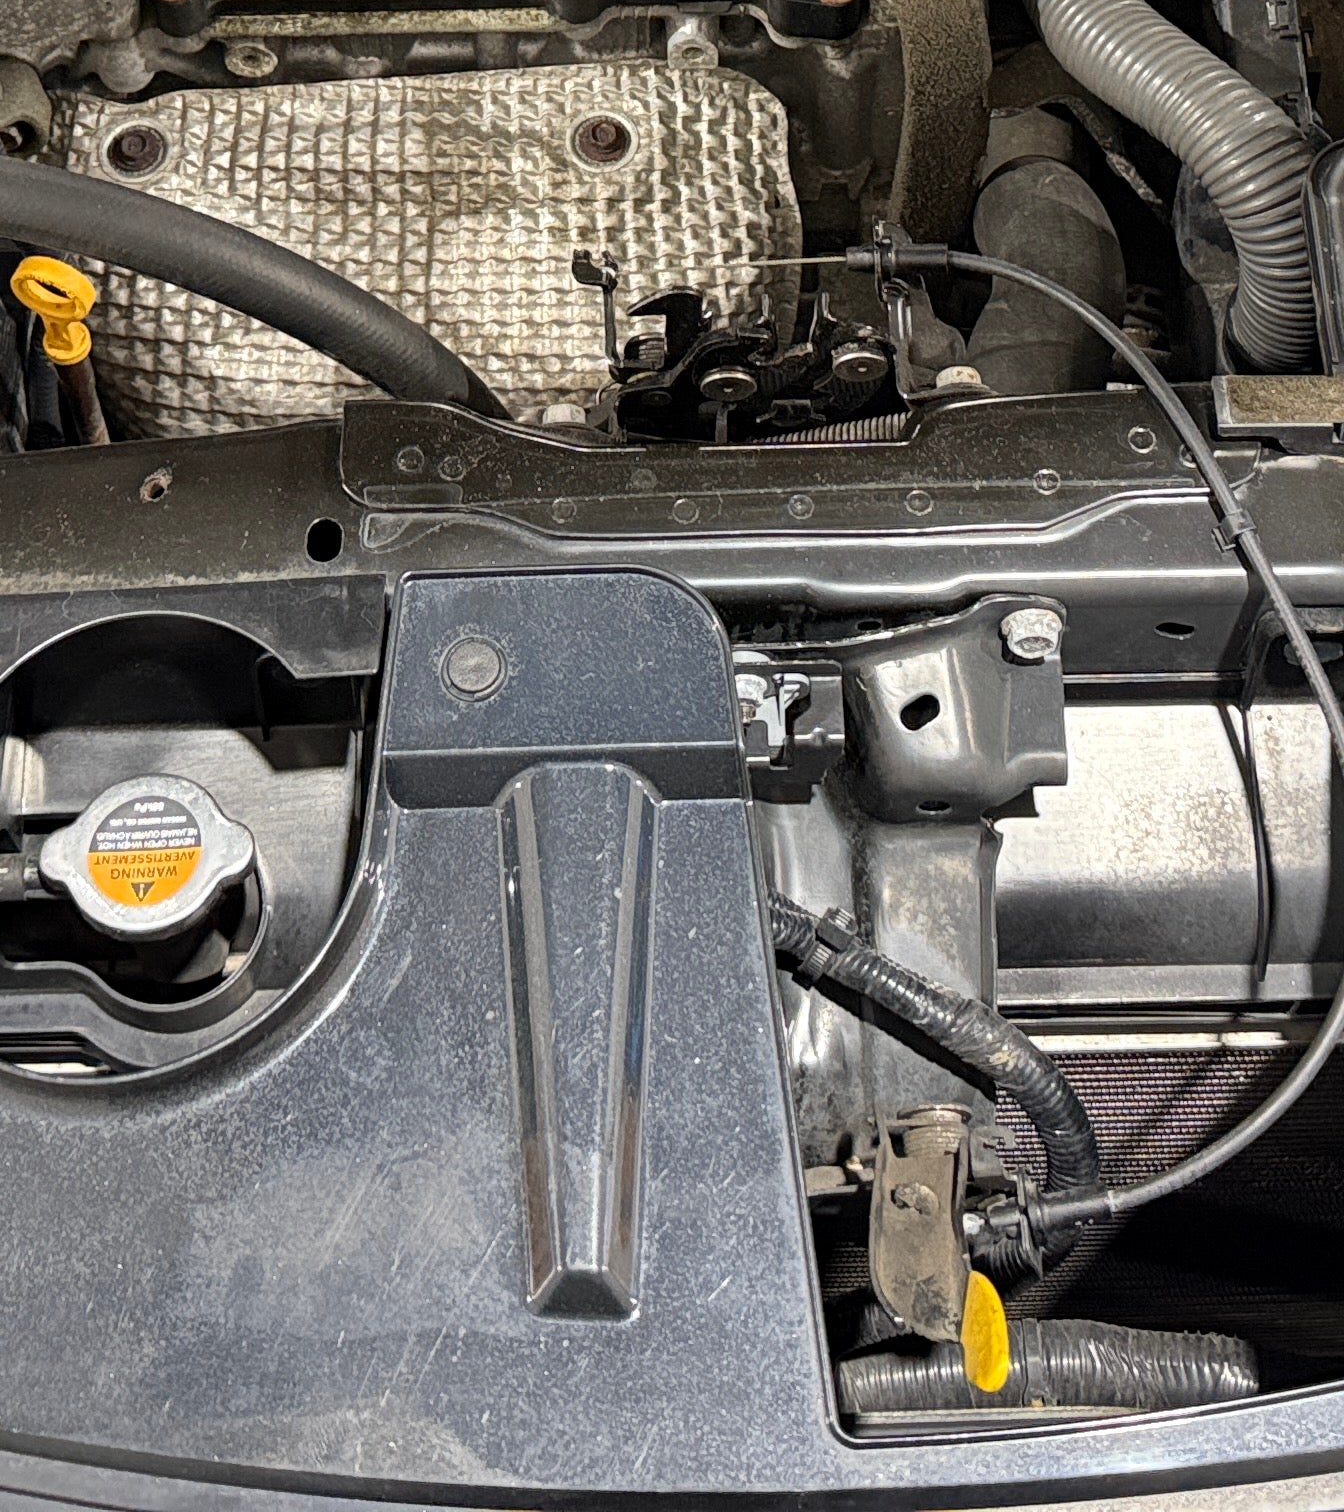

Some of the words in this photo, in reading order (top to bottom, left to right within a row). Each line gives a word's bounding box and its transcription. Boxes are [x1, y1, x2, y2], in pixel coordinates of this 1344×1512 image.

[117, 840, 143, 848] WHEN
[144, 838, 167, 847] OPEN
[168, 837, 195, 847] NEVER
[94, 851, 195, 865] AVERTISSEMENT
[111, 865, 177, 879] WARNING
